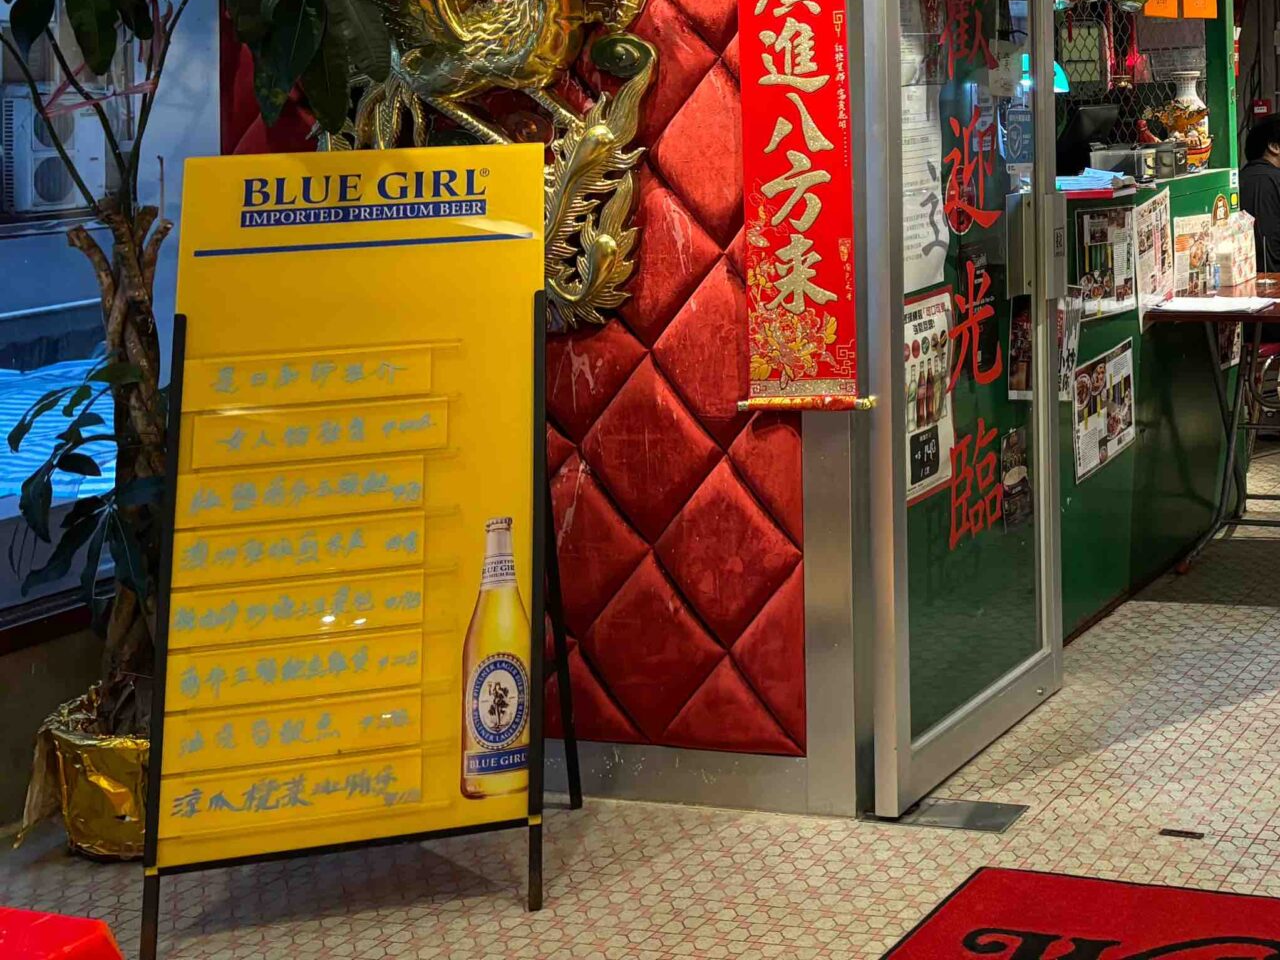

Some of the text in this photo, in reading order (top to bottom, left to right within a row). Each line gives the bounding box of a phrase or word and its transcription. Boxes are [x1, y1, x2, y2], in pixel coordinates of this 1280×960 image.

[243, 173, 362, 207] BLUE
[245, 201, 483, 225] IMPORTED PREMIUM BEER
[469, 757, 498, 769] BLUE
